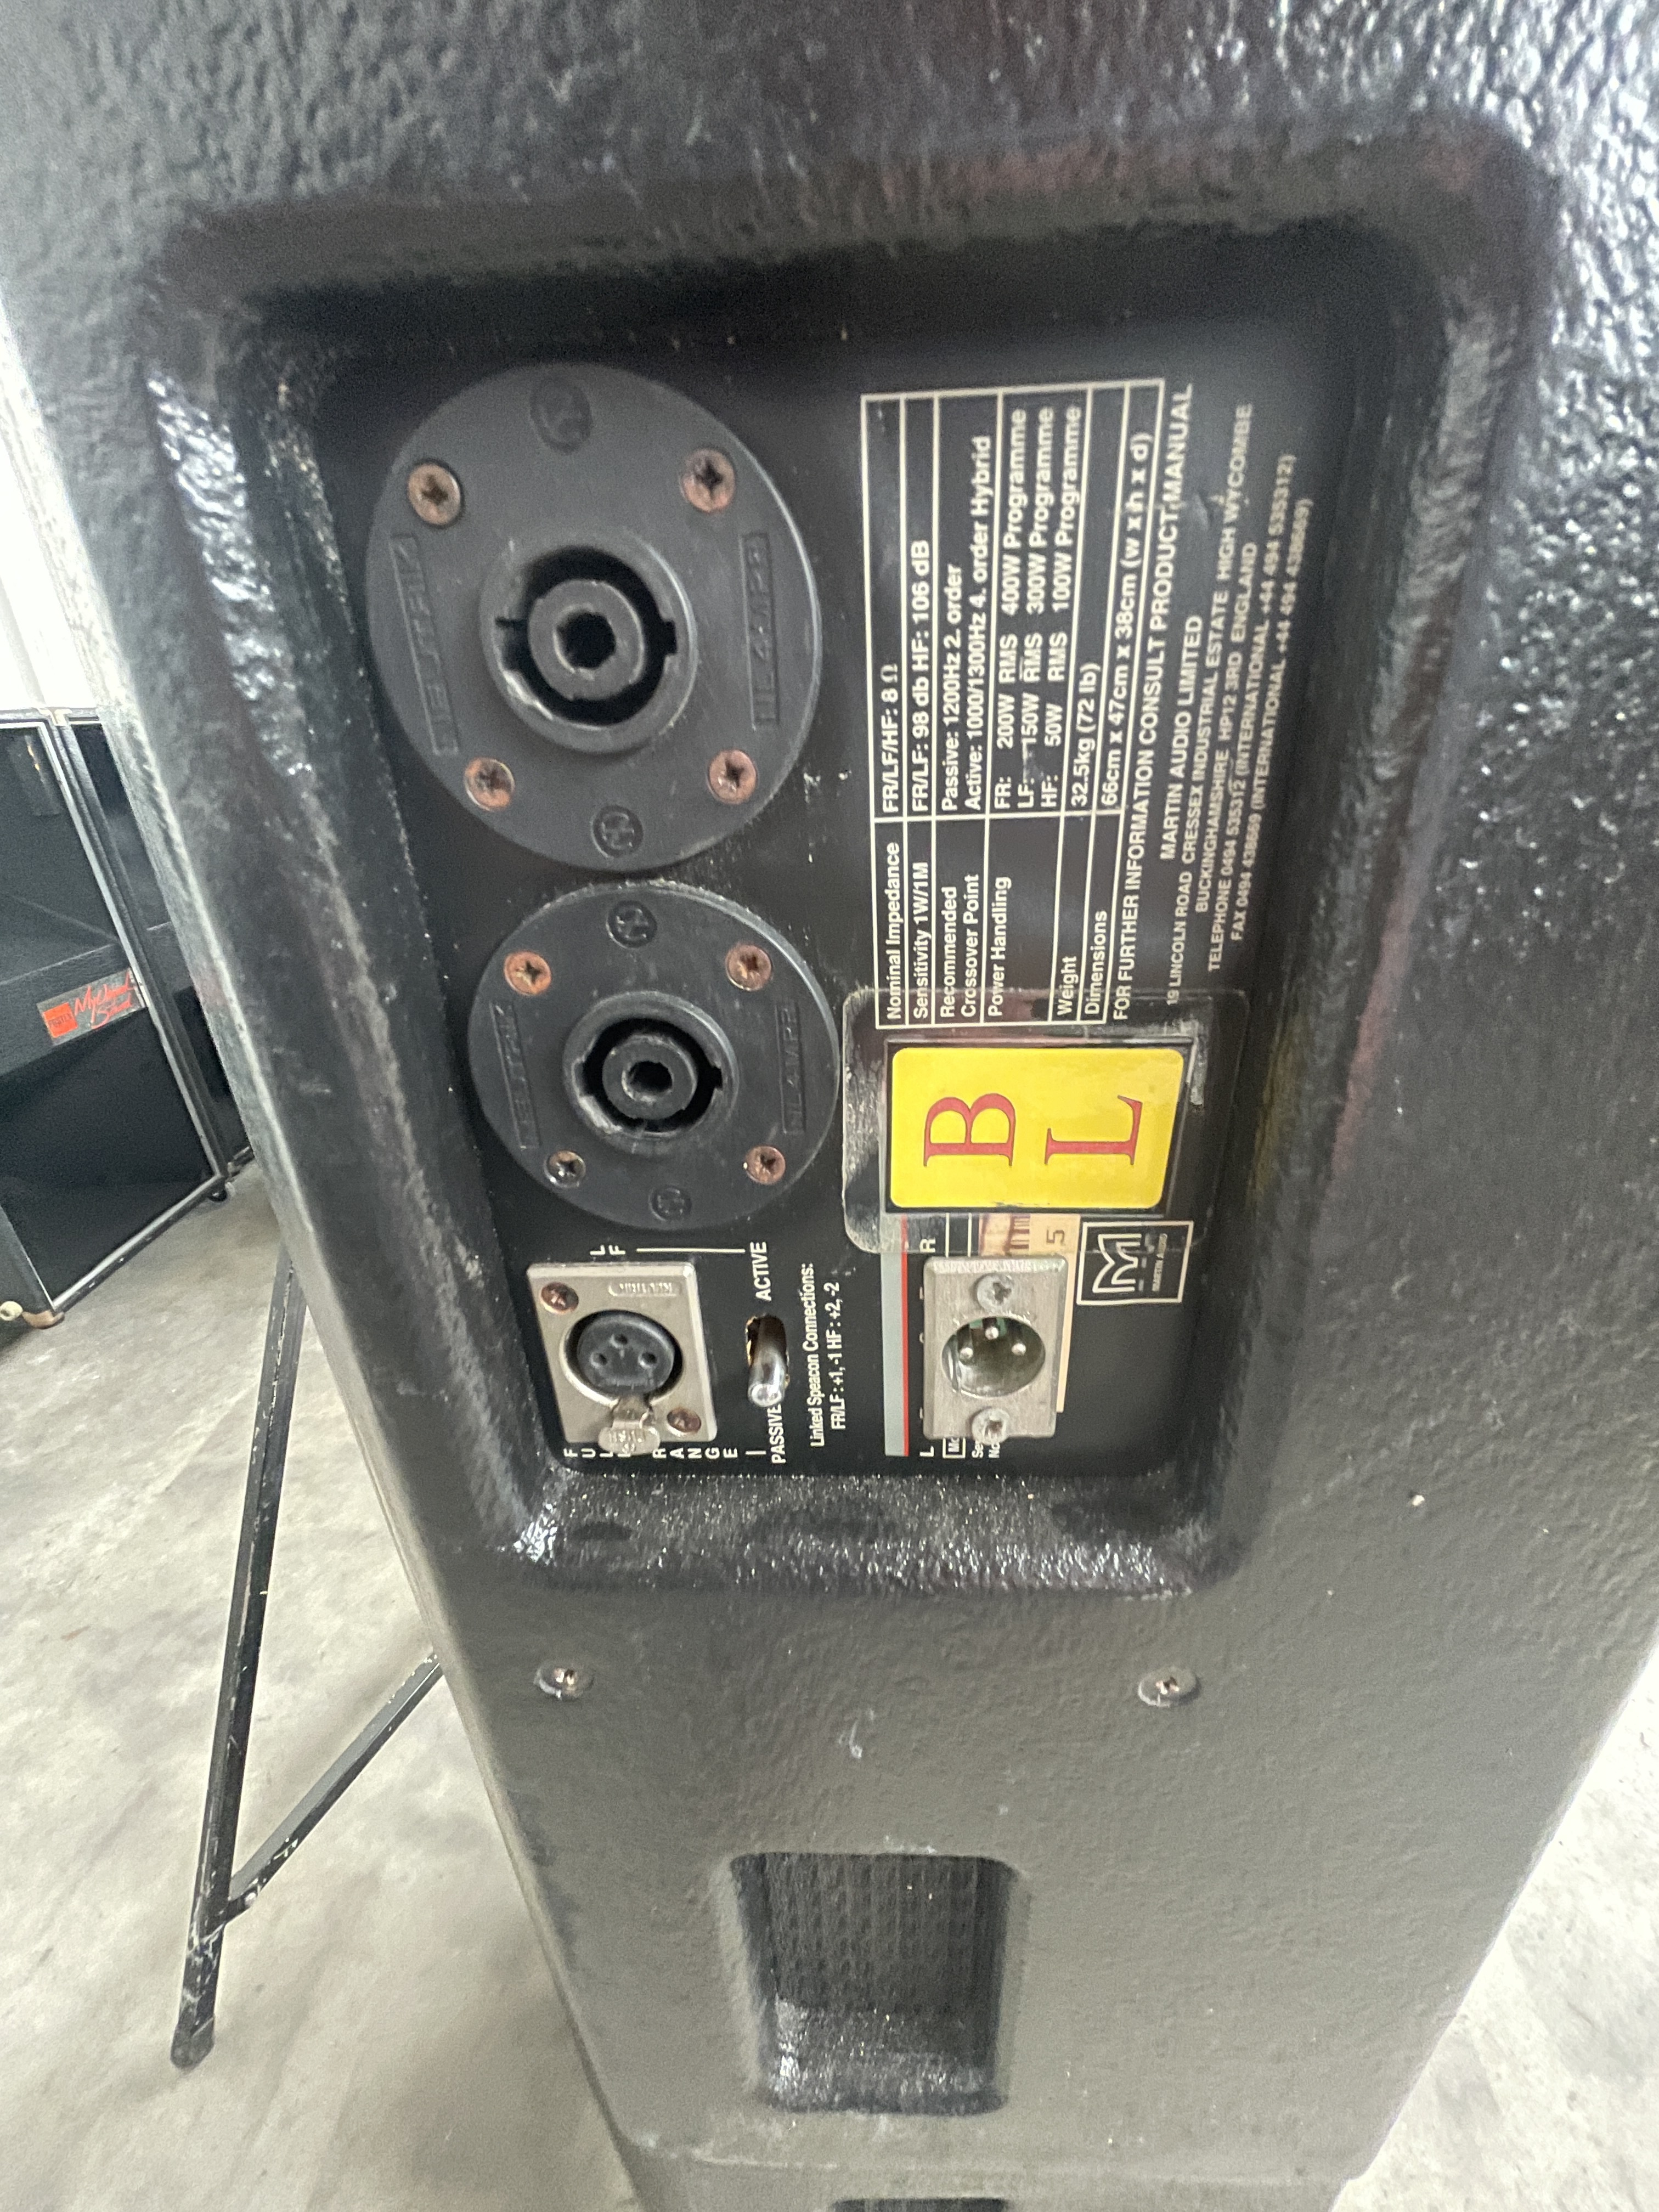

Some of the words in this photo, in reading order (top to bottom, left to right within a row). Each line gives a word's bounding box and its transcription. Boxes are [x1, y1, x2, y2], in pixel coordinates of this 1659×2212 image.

[1131, 432, 1153, 461] d)
[1162, 383, 1193, 502] MANUAL
[1223, 403, 1252, 522] WYCOMBE
[970, 436, 994, 516] Hybrid
[1004, 408, 1028, 549] Programme
[1029, 408, 1054, 548] Programme
[1053, 407, 1081, 546] Programme
[1125, 492, 1145, 511] h
[1131, 470, 1145, 483] x
[970, 522, 988, 583] order
[1121, 537, 1143, 568] (w
[1127, 517, 1141, 531] x
[1218, 528, 1237, 580] HIGH
[912, 541, 930, 577] dB
[1001, 554, 1022, 616] 400W
[1027, 554, 1046, 614] 300W
[1052, 552, 1071, 612] 100W
[1150, 511, 1178, 631] PRODUCT
[1263, 540, 1280, 576] 494
[912, 582, 930, 624] 106
[945, 564, 962, 624] order
[969, 588, 987, 607] 4.
[1114, 574, 1137, 639] 38cm
[1230, 543, 1258, 643] ENGLAND
[1259, 580, 1276, 614] +44
[912, 631, 930, 671] HF:
[944, 628, 961, 648] 2.
[1000, 634, 1018, 683] RMS
[1024, 633, 1043, 683] RMS
[1049, 632, 1068, 682] RMS
[1115, 645, 1129, 658] x
[1205, 591, 1229, 668] ESTATE
[943, 653, 961, 726] 1200Hz
[966, 613, 987, 740] 1000/1300Hz
[1078, 663, 1101, 694] lb)
[1140, 637, 1166, 744] CONSULT
[1177, 616, 1203, 706] LIMITED
[1224, 652, 1243, 691] 3RD
[882, 688, 899, 703] 8
[912, 677, 930, 706] db
[997, 693, 1015, 749] 200W
[1022, 693, 1040, 746] 150W
[1076, 699, 1097, 732] (72
[1107, 664, 1130, 725] 47cm
[1218, 694, 1237, 741] HP12
[1234, 621, 1270, 776] (INTERNATIONAL
[913, 712, 929, 738] 98
[1045, 703, 1063, 747] 50W
[1110, 730, 1123, 743] x
[1172, 712, 1193, 778] AUDIO
[1191, 673, 1219, 781] INDUSTRIAL
[1250, 659, 1286, 810] (INTERNATIONAL
[882, 709, 899, 812] FR/LF/HF:
[913, 744, 929, 811] FR/LF:
[942, 731, 960, 811] Passive:
[965, 745, 984, 810] Active:
[1073, 738, 1095, 806] 32.5kg
[1102, 749, 1122, 806] 66cm
[995, 776, 1012, 809] FR:
[1018, 778, 1036, 808] LF:
[1041, 775, 1059, 807] HF:
[1125, 750, 1154, 890] INFORMATION
[1227, 780, 1246, 835] 535312
[1160, 784, 1182, 860] MARTIN
[1182, 786, 1204, 865] CRESSEX
[1195, 749, 1230, 912] BUCKINGHAMSHIRE
[1221, 840, 1238, 875] 0494
[886, 842, 904, 945] Impedance
[913, 862, 928, 924] 1W/1M
[964, 874, 979, 924] Point
[991, 877, 1011, 960] Handling
[1175, 872, 1193, 917] ROAD
[1235, 872, 1252, 907] 0494
[941, 887, 956, 1017] Recommended
[1118, 895, 1139, 980] FURTHER
[1169, 921, 1187, 986] LINCOLN
[1208, 880, 1232, 972] TELEPHONE
[1231, 911, 1247, 940] FAX
[885, 950, 901, 1019] Nominal
[913, 930, 932, 1018] Sensitivity
[963, 930, 979, 1017] Crossover
[988, 964, 1005, 1016] Power
[1057, 956, 1079, 1015] Weight
[1085, 911, 1108, 1014] Dimensions
[1113, 986, 1132, 1020] FOR
[923, 1093, 1016, 1167] B
[1044, 1095, 1143, 1165] L
[750, 1242, 772, 1301] ACTIVE
[802, 1263, 818, 1351] Connections:
[806, 1355, 823, 1406] Speacon
[652, 1447, 738, 1458] RANGE
[767, 1404, 786, 1463] PASSIVE
[808, 1408, 825, 1446] Linked
